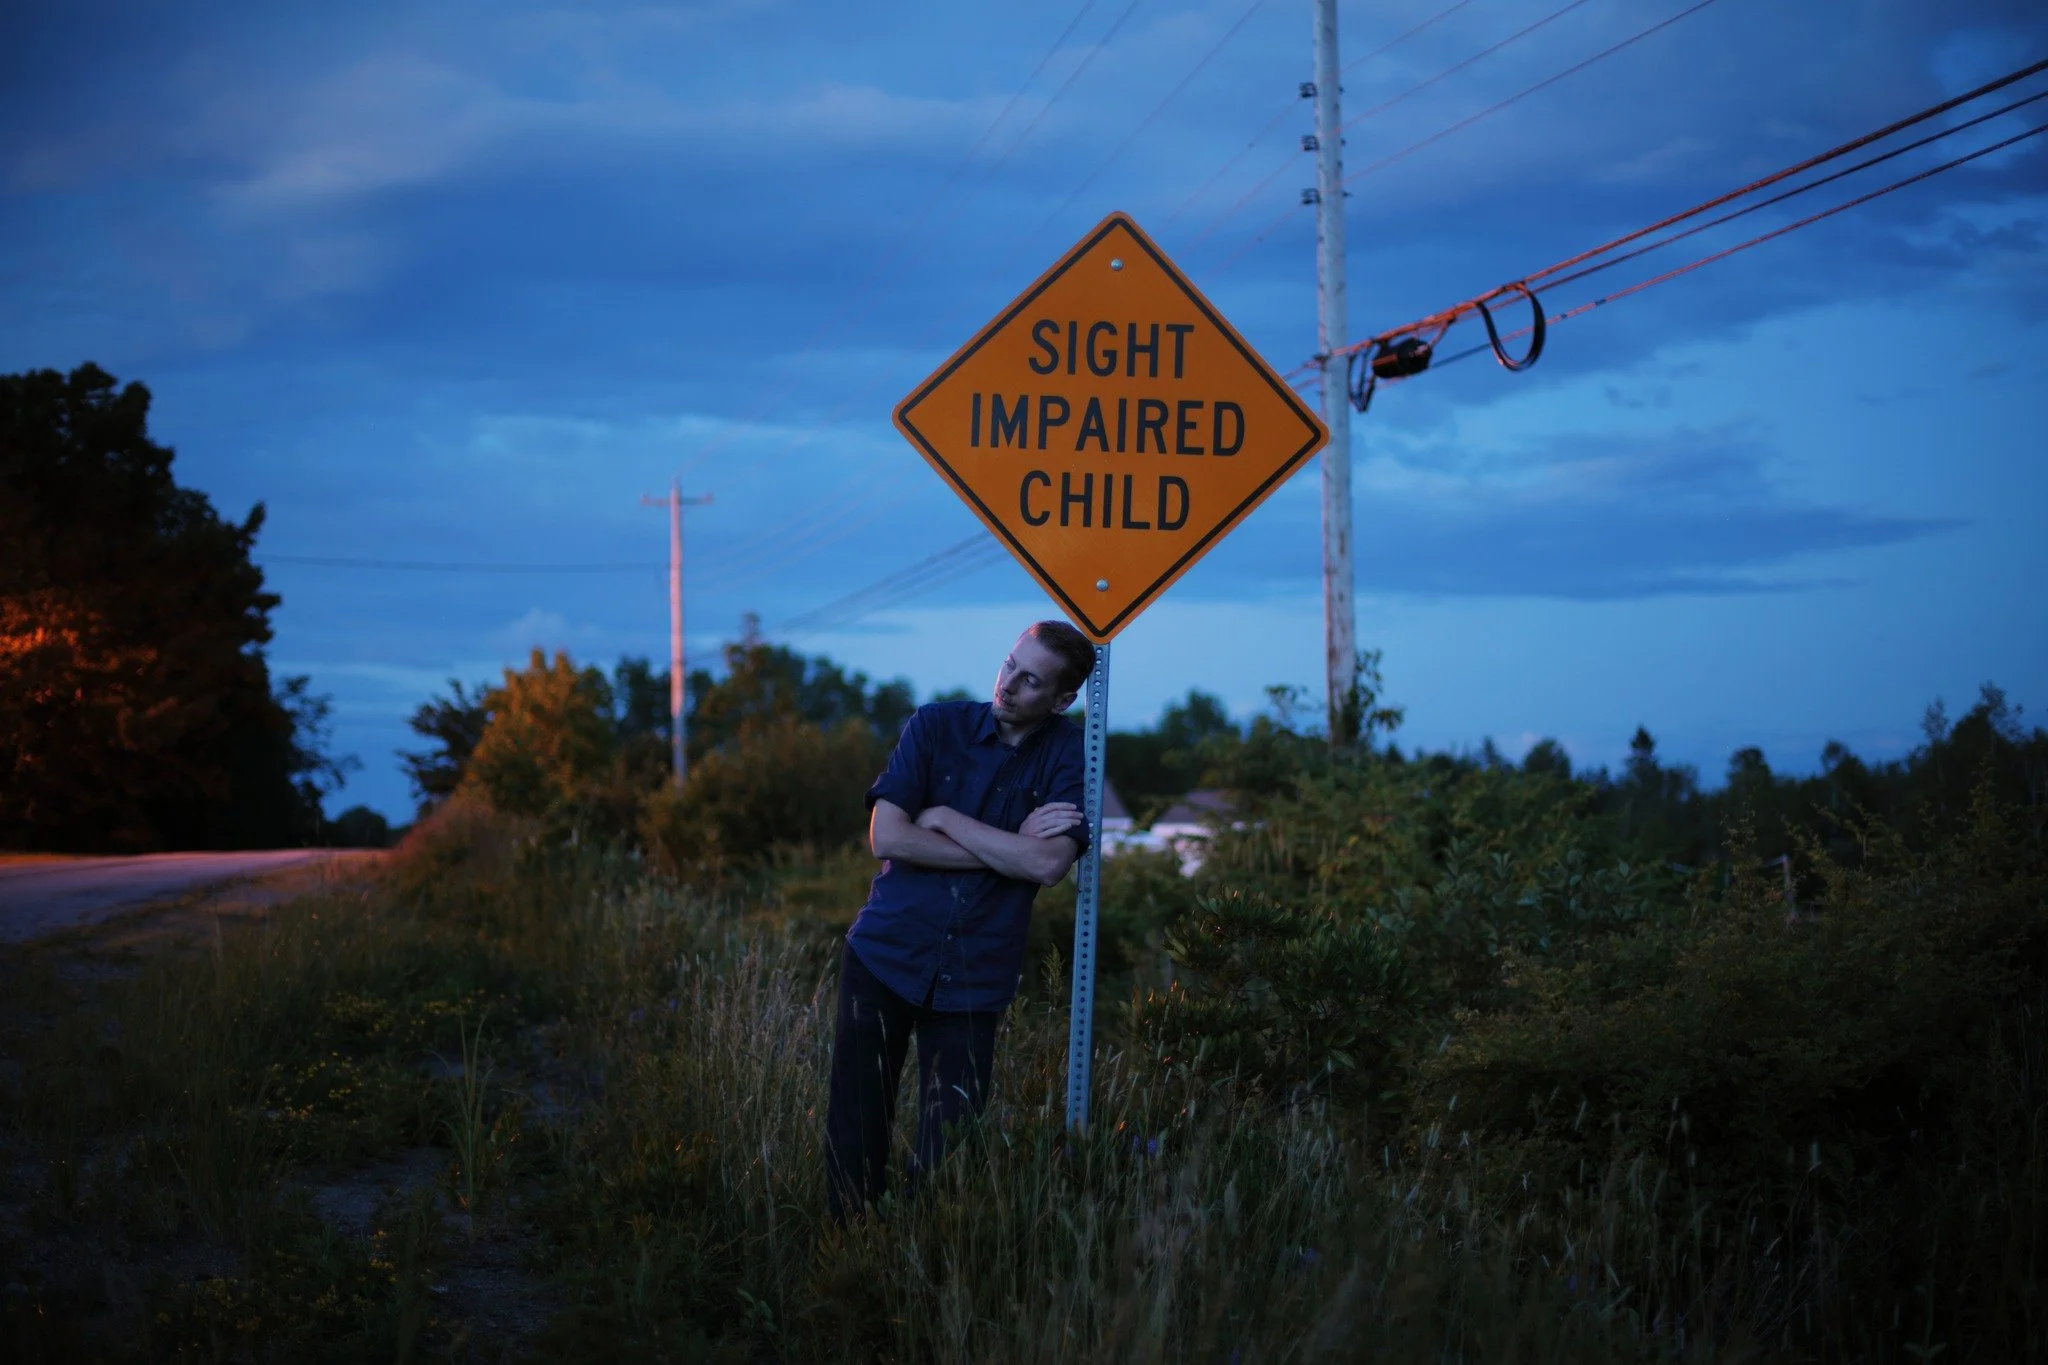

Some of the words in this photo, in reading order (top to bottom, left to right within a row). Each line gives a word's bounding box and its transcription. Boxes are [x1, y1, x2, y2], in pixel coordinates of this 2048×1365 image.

[1027, 318, 1196, 380] SIGHT
[969, 391, 1247, 458] IMPAIRED
[1018, 468, 1192, 532] CHILD
